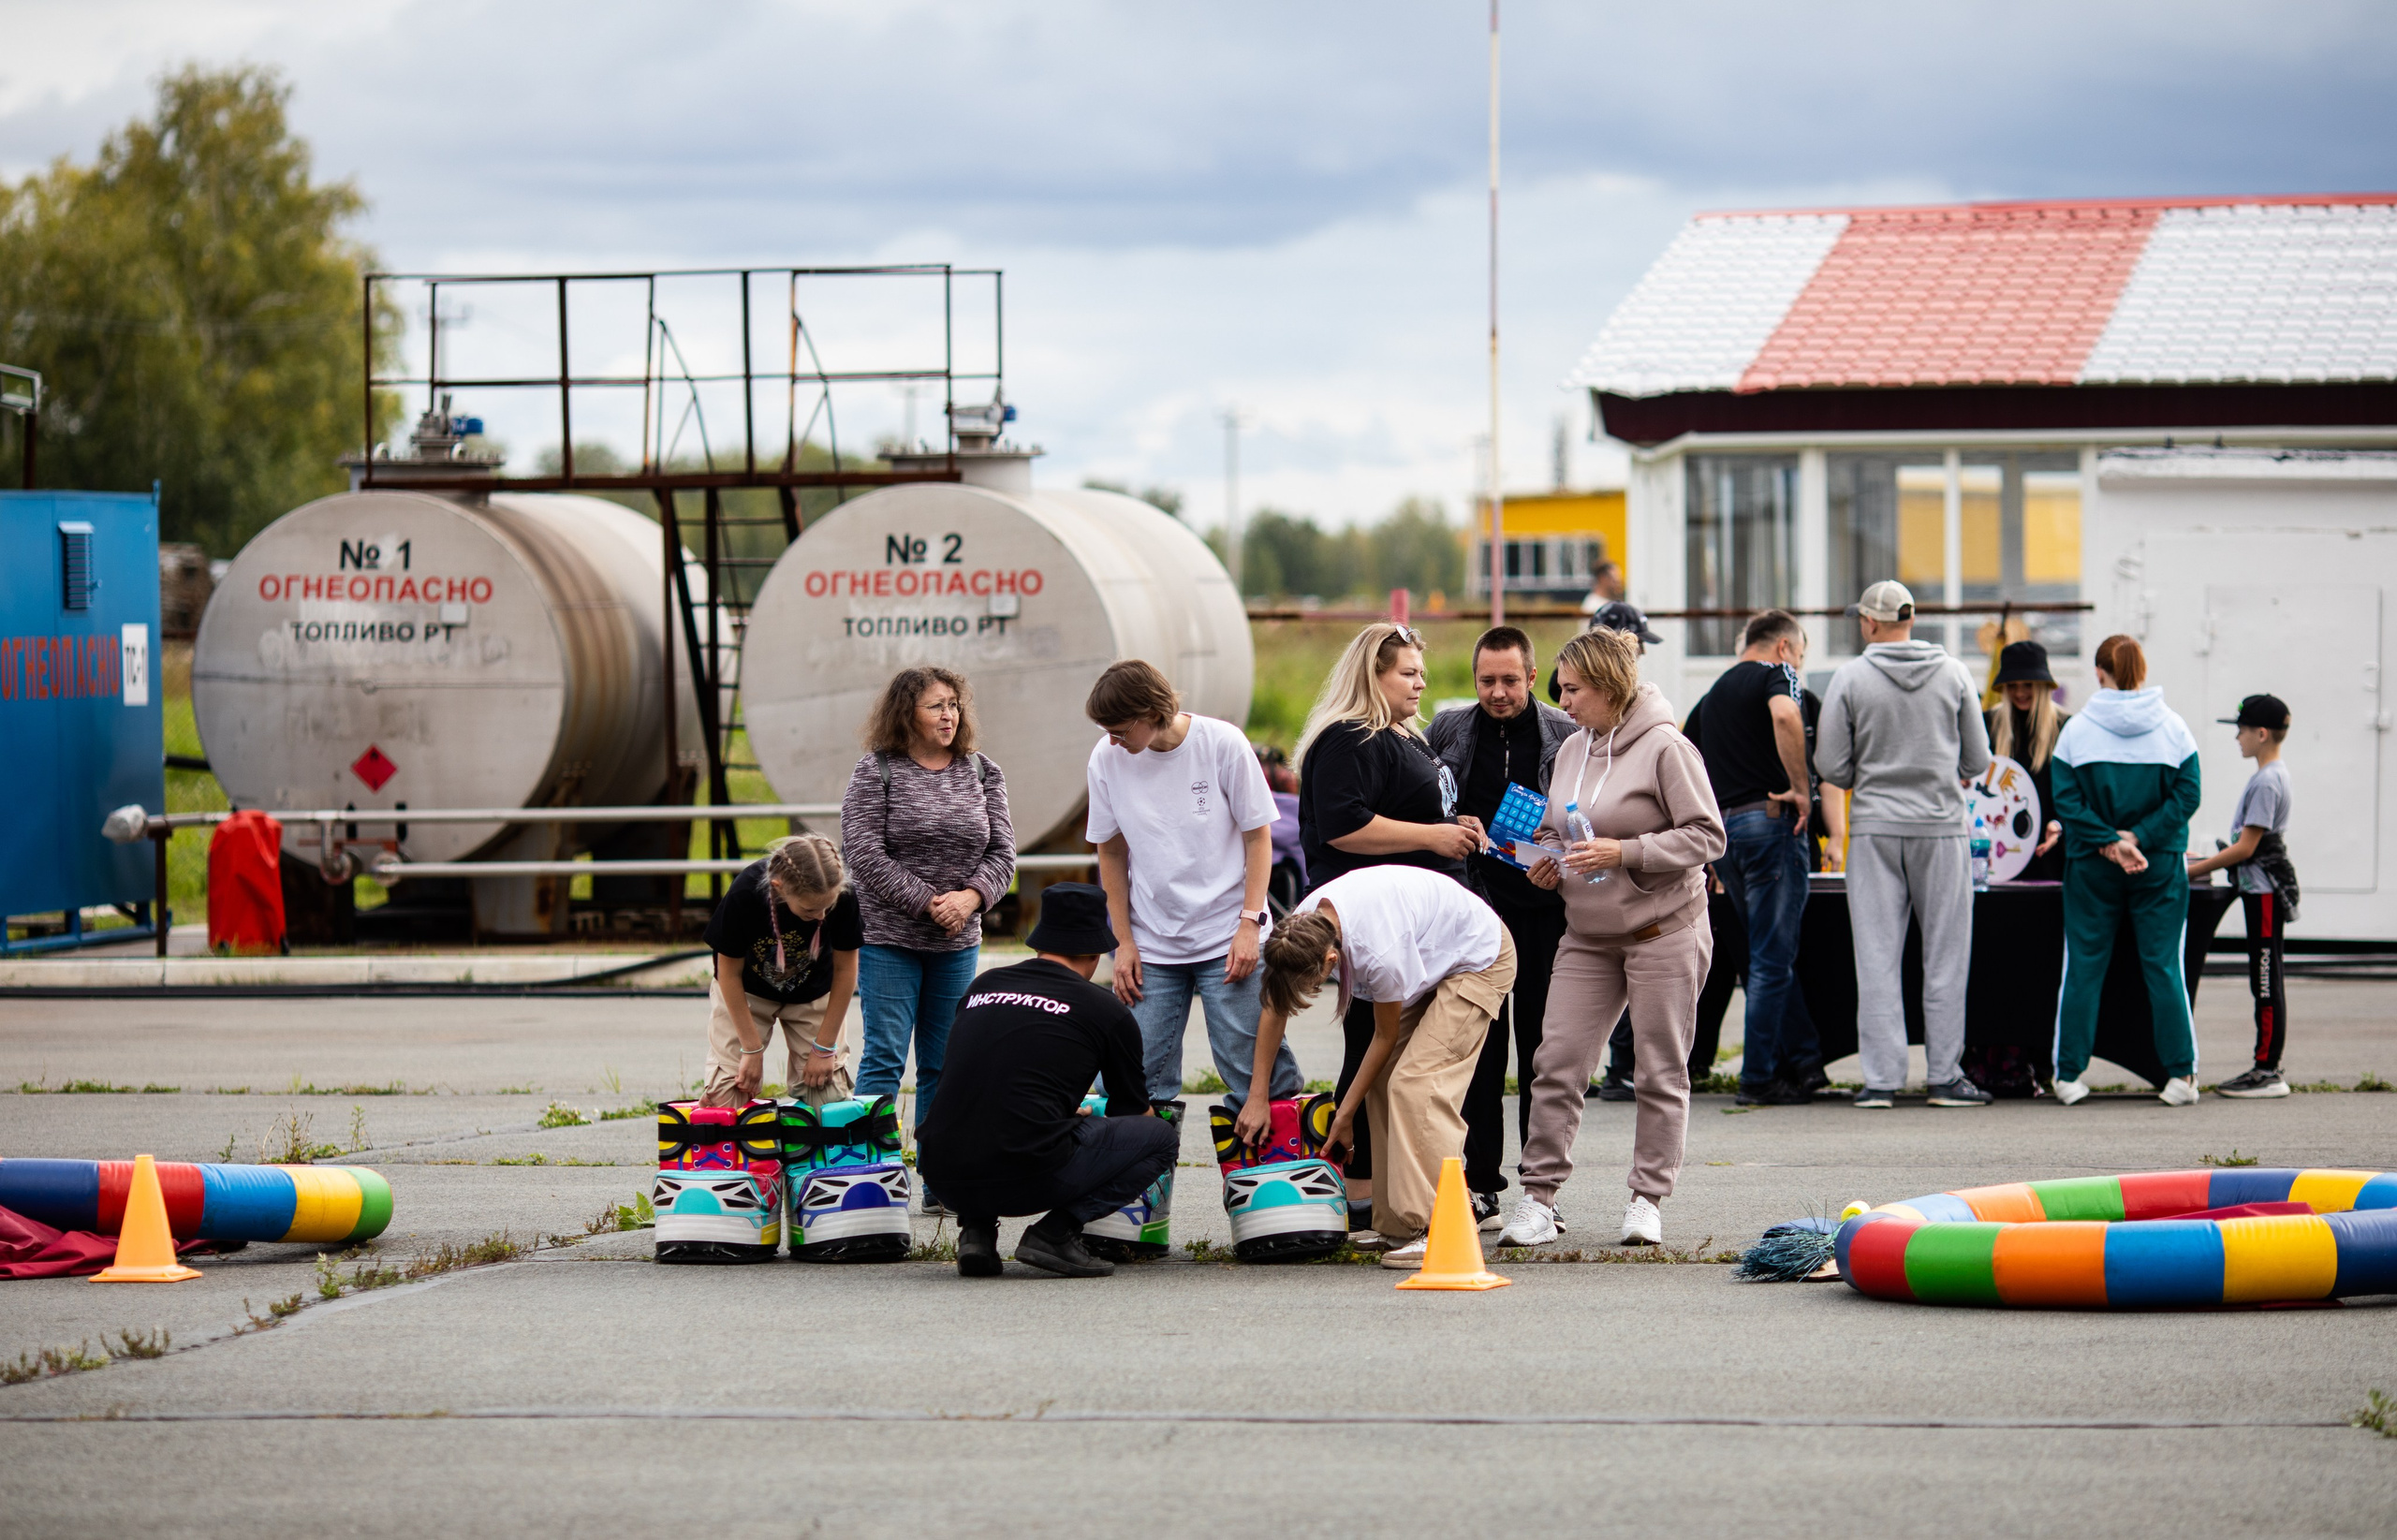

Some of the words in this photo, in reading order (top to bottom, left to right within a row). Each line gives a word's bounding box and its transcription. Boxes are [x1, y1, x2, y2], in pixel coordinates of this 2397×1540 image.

[340, 539, 380, 570] №
[397, 539, 412, 570] 1
[886, 533, 928, 565] №
[942, 533, 963, 564] 2
[258, 575, 493, 604] ОГНЕОПАСНО
[804, 569, 1044, 598] ОГНЕОПАСНО
[290, 622, 416, 643] ТОПЛИВО
[424, 623, 455, 643] РТ
[843, 617, 969, 637] ТОПЛИВО
[978, 617, 1008, 637] РТ
[2, 635, 120, 700] ОГНЕОПАСНО
[2259, 947, 2271, 998] POSITIVE
[966, 992, 1070, 1015] ИНСТРУКТОР
